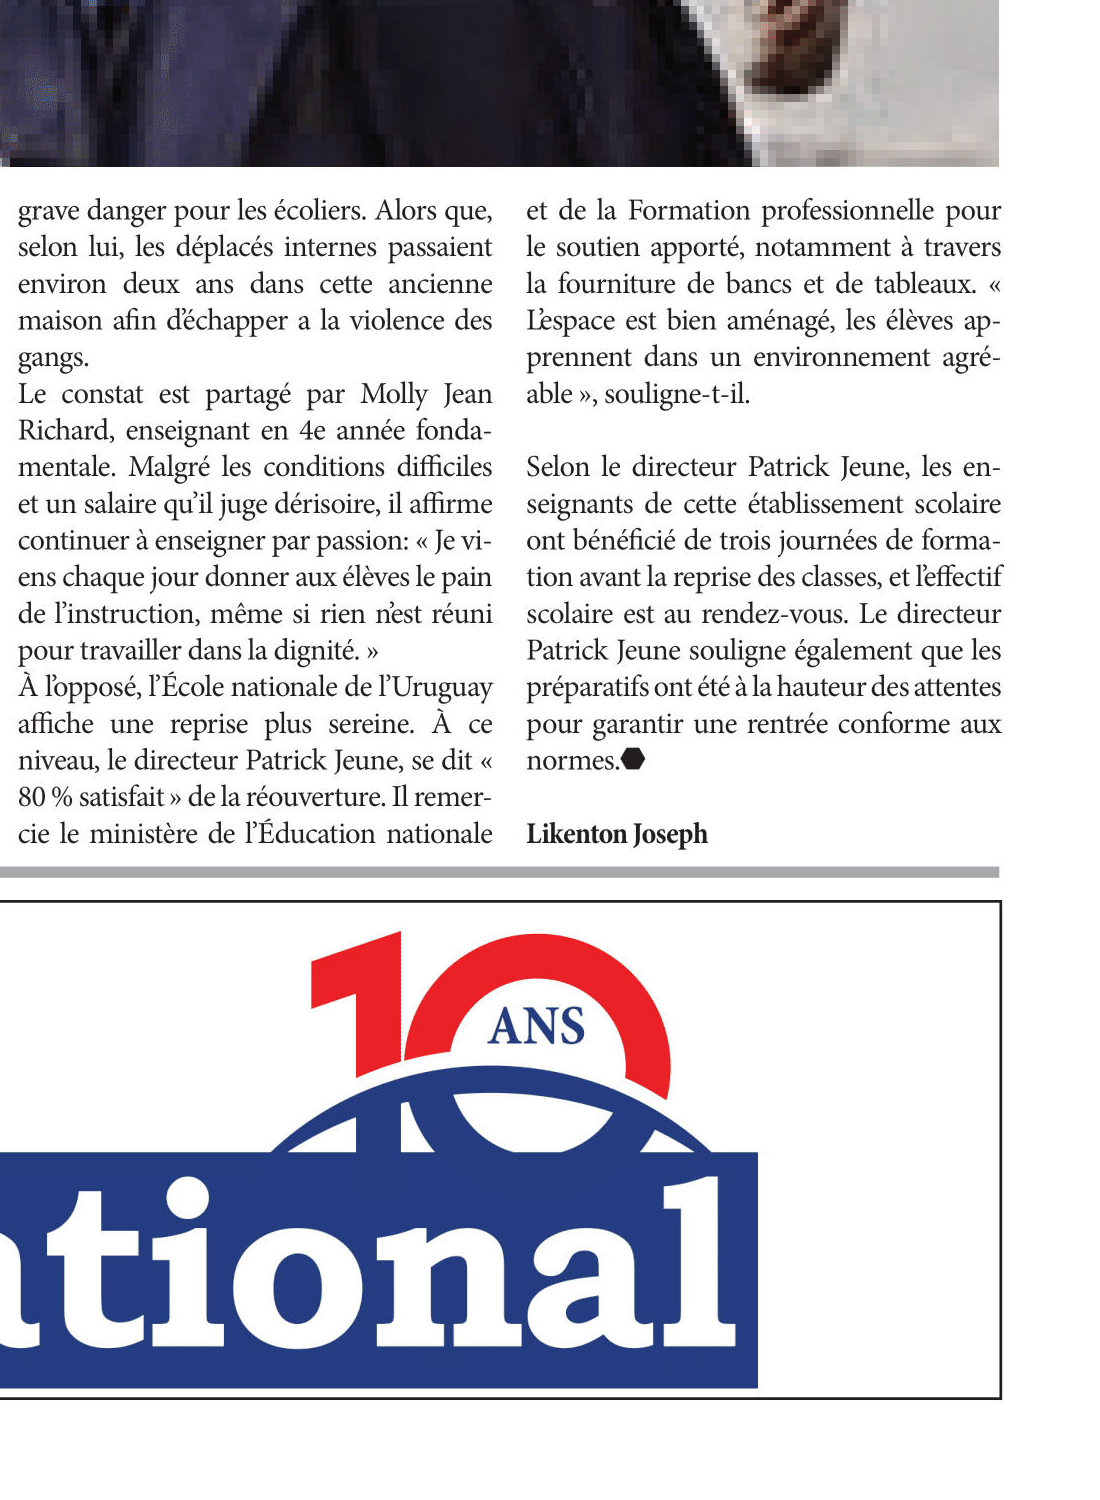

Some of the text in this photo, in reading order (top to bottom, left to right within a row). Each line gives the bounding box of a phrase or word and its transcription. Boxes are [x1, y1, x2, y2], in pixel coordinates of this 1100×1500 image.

[17, 197, 493, 228] grave danger pour les écoliers. Alors que,
[526, 197, 1002, 228] et de la Formation professionnelle pour
[18, 233, 493, 264] selon lui, les déplacés internes passaient
[526, 343, 1001, 375] prennent dans un environnement agré-
[18, 417, 492, 448] Richard, enseignant en 4e année fonda-
[17, 453, 493, 485] mentale. Malgré les conditions difficiles
[526, 453, 1001, 482] Selon le directeur Patrick Jeune, les en-
[526, 600, 1002, 624] scolaire est au rendez-vous. Le directeur
[18, 707, 493, 741] affiche une reprise plus sereine. À ce
[527, 755, 620, 771] normes.
[526, 821, 709, 851] Likenton Joseph
[487, 1005, 585, 1045] ANS
